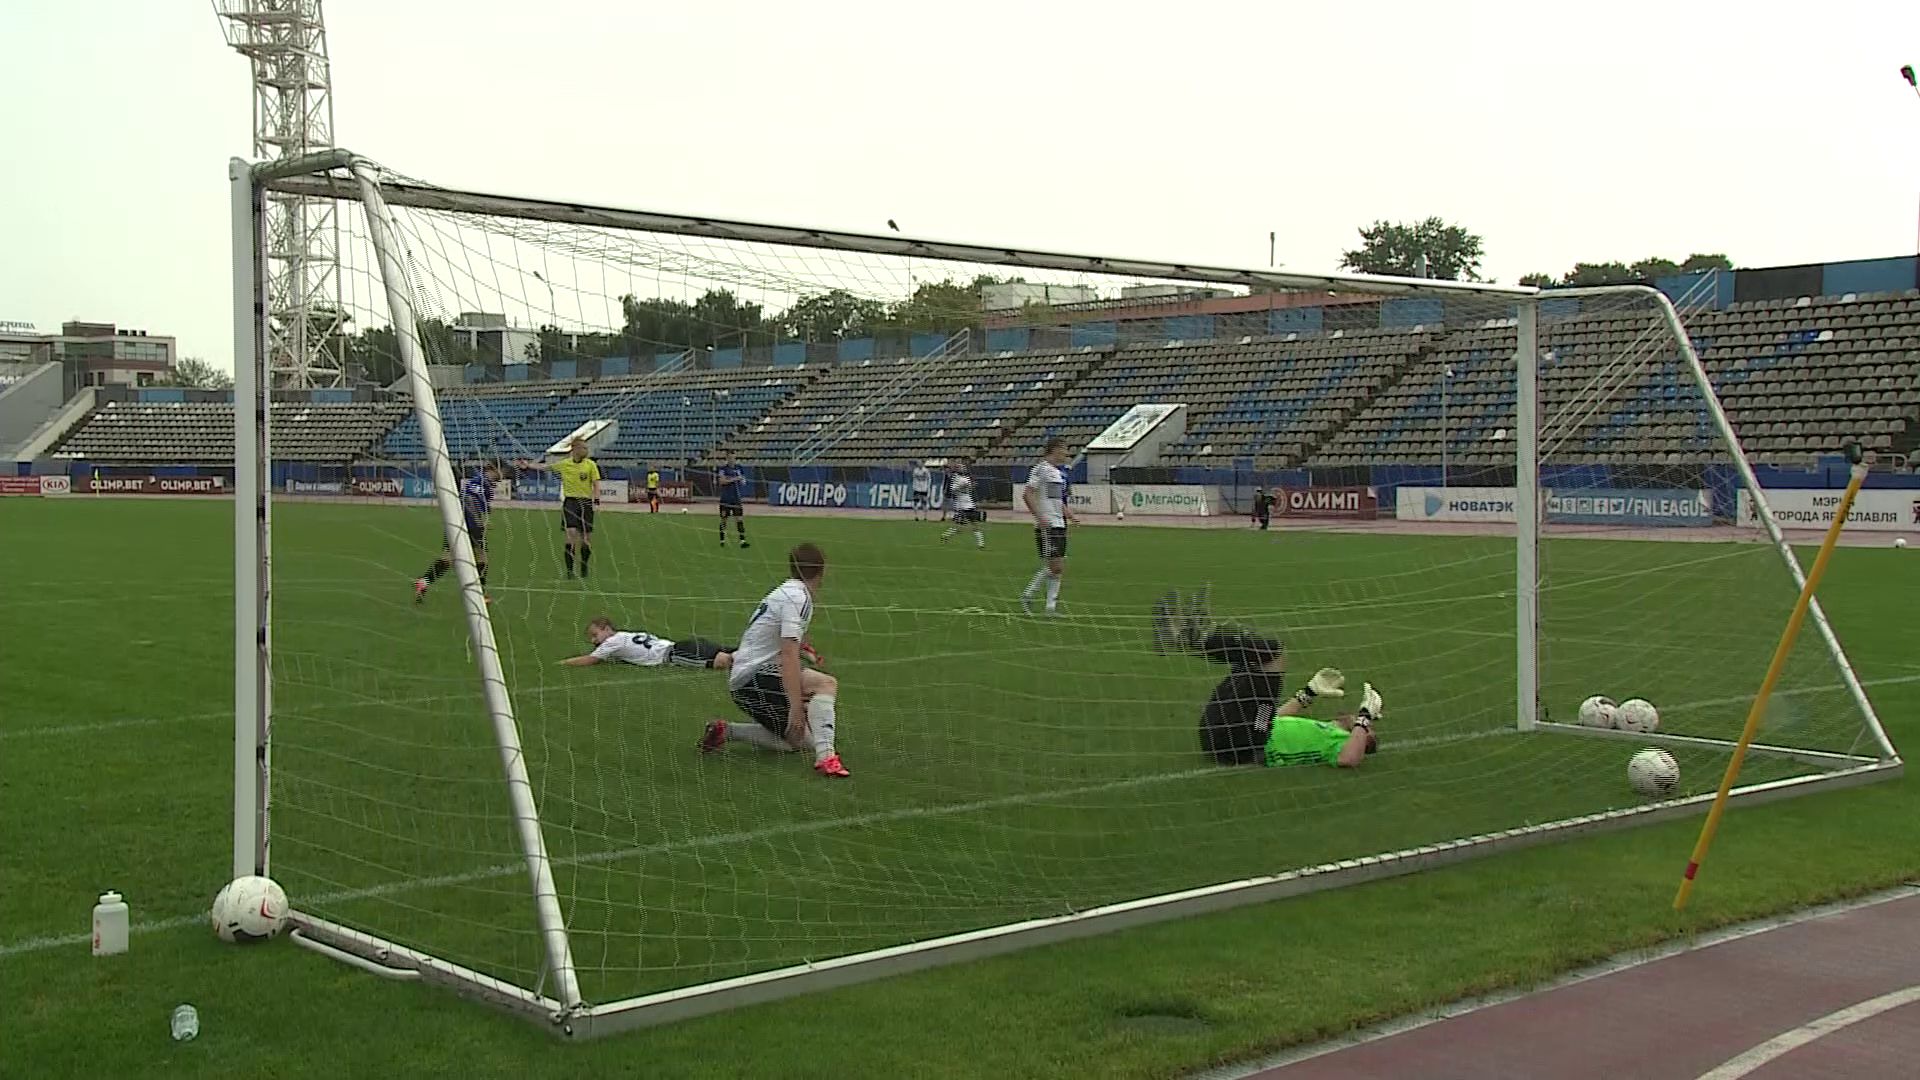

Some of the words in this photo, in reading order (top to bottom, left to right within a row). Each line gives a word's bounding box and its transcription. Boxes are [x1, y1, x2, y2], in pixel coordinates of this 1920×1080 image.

[46, 479, 66, 489] KIA
[90, 479, 144, 491] OLIMP.BET
[160, 479, 212, 491] OLIMP.BET
[778, 483, 847, 506] 1ФНЛ.РФ
[1290, 492, 1360, 510] ОЛИМП
[1449, 500, 1514, 513] НОВАТЭК
[1812, 496, 1855, 507] МЭР
[1772, 510, 1820, 523] ГОРОДА
[1822, 511, 1897, 523] ЯРСЛАВЛЯ
